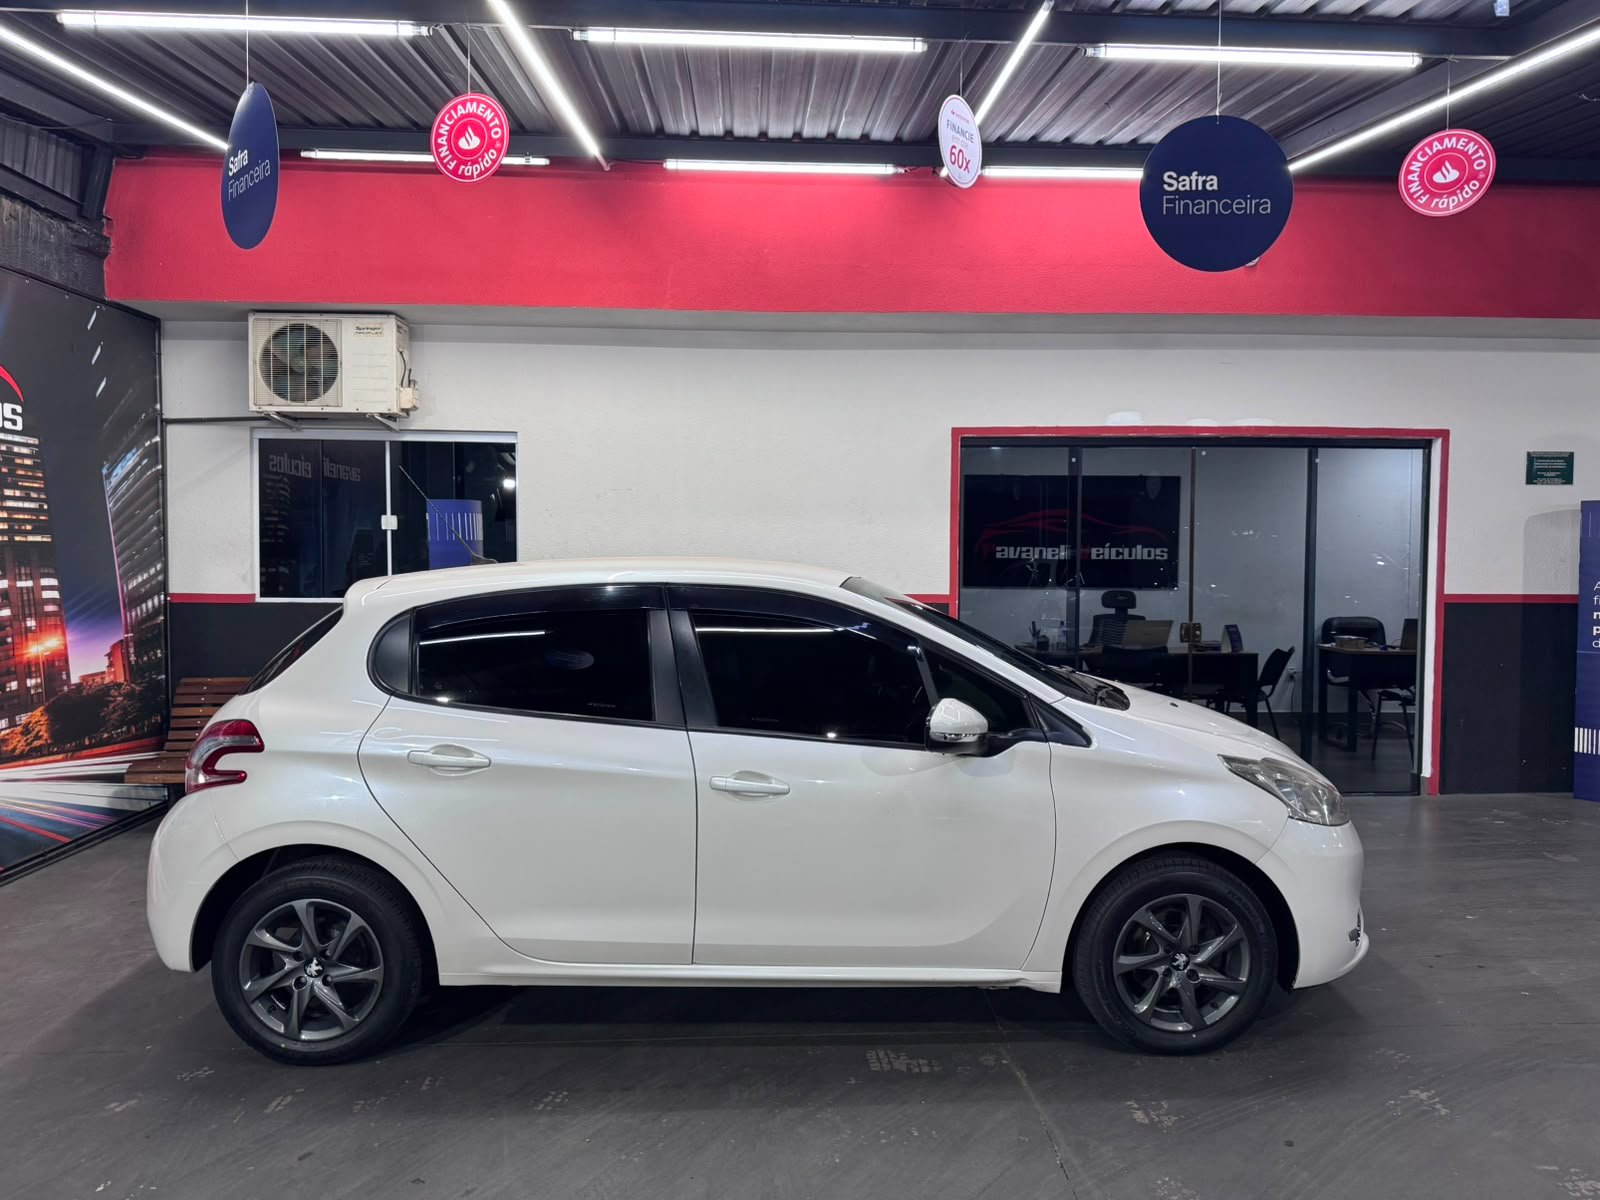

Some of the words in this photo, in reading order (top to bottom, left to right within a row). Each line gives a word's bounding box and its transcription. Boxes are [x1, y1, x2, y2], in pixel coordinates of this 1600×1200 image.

[437, 101, 502, 171] FINANCIAMENTO
[946, 119, 975, 144] FINANCIE
[228, 149, 249, 177] Safra
[458, 148, 498, 180] rápido
[949, 144, 971, 174] 60x
[1407, 136, 1487, 205] FINANCIAMENTO
[228, 159, 271, 203] Financeira
[1162, 171, 1219, 191] Safra
[1430, 179, 1480, 210] rápido
[1162, 194, 1272, 215] Financeira
